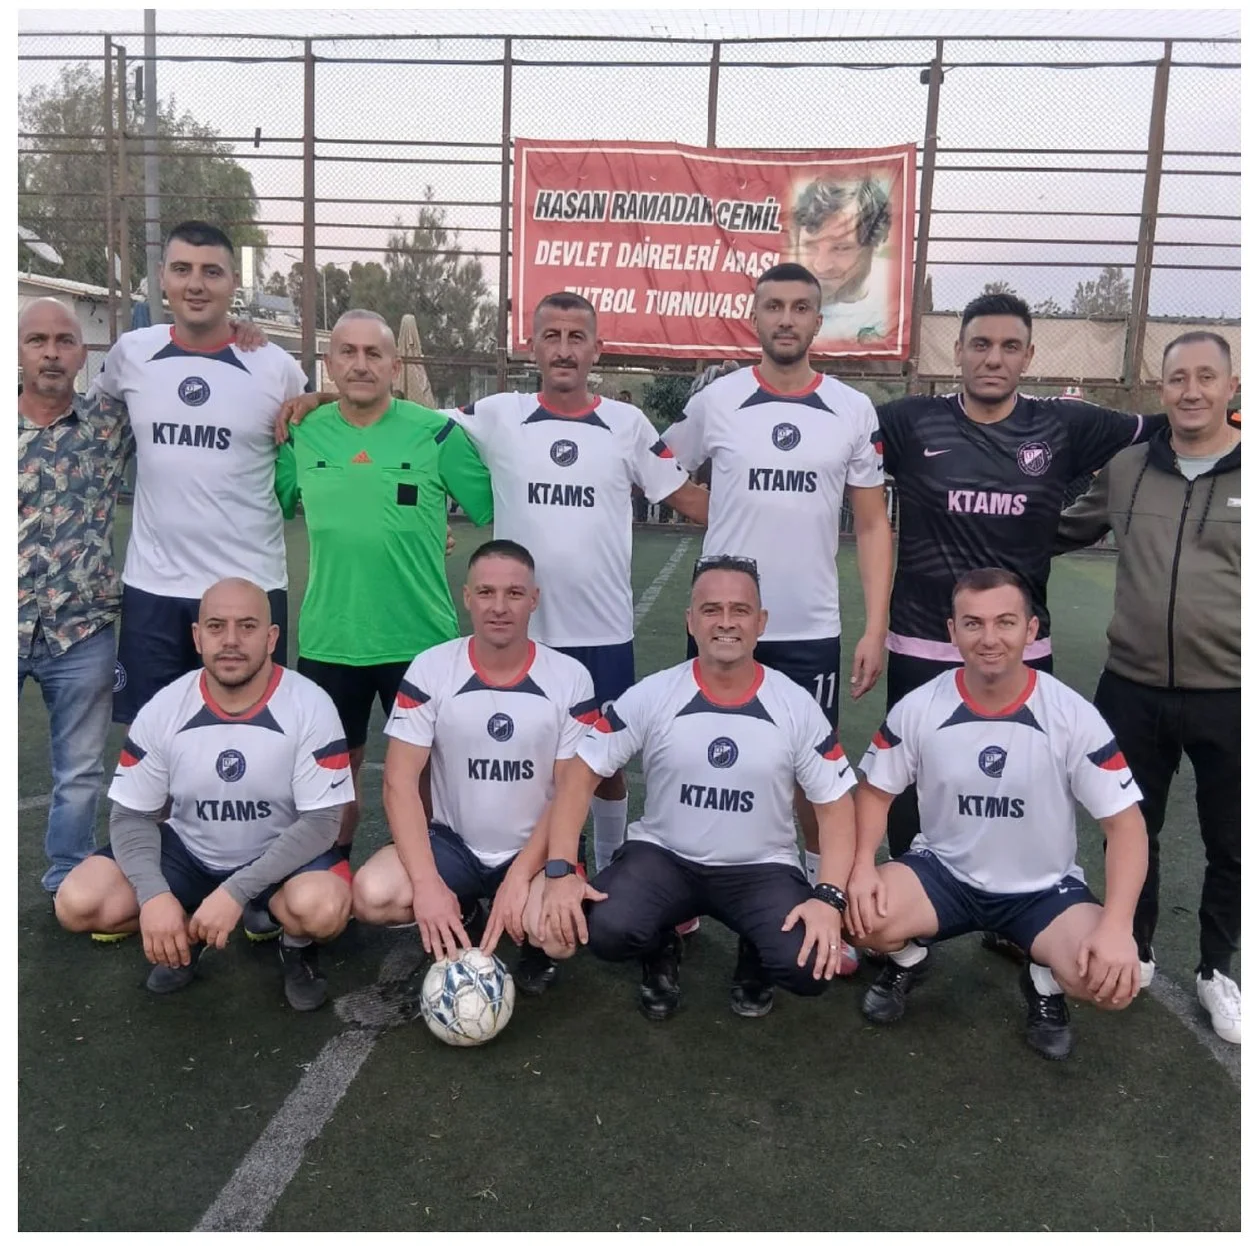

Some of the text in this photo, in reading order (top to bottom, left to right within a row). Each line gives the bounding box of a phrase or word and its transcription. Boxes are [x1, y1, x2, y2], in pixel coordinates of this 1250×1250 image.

[533, 190, 783, 234] HASAN RAMADAN CEMİL
[535, 240, 612, 268] DEVLET
[615, 236, 721, 271] DAİRELERİ
[645, 289, 755, 319] TURNUVASI
[152, 422, 232, 450] KTAMS
[748, 467, 818, 493] KTAMS
[528, 482, 595, 508] KTAMS
[947, 490, 1027, 516] KTAMS
[813, 672, 836, 709] 11
[467, 758, 534, 781] KTAMS
[195, 800, 272, 821] KTAMS
[679, 784, 754, 813] KTAMS
